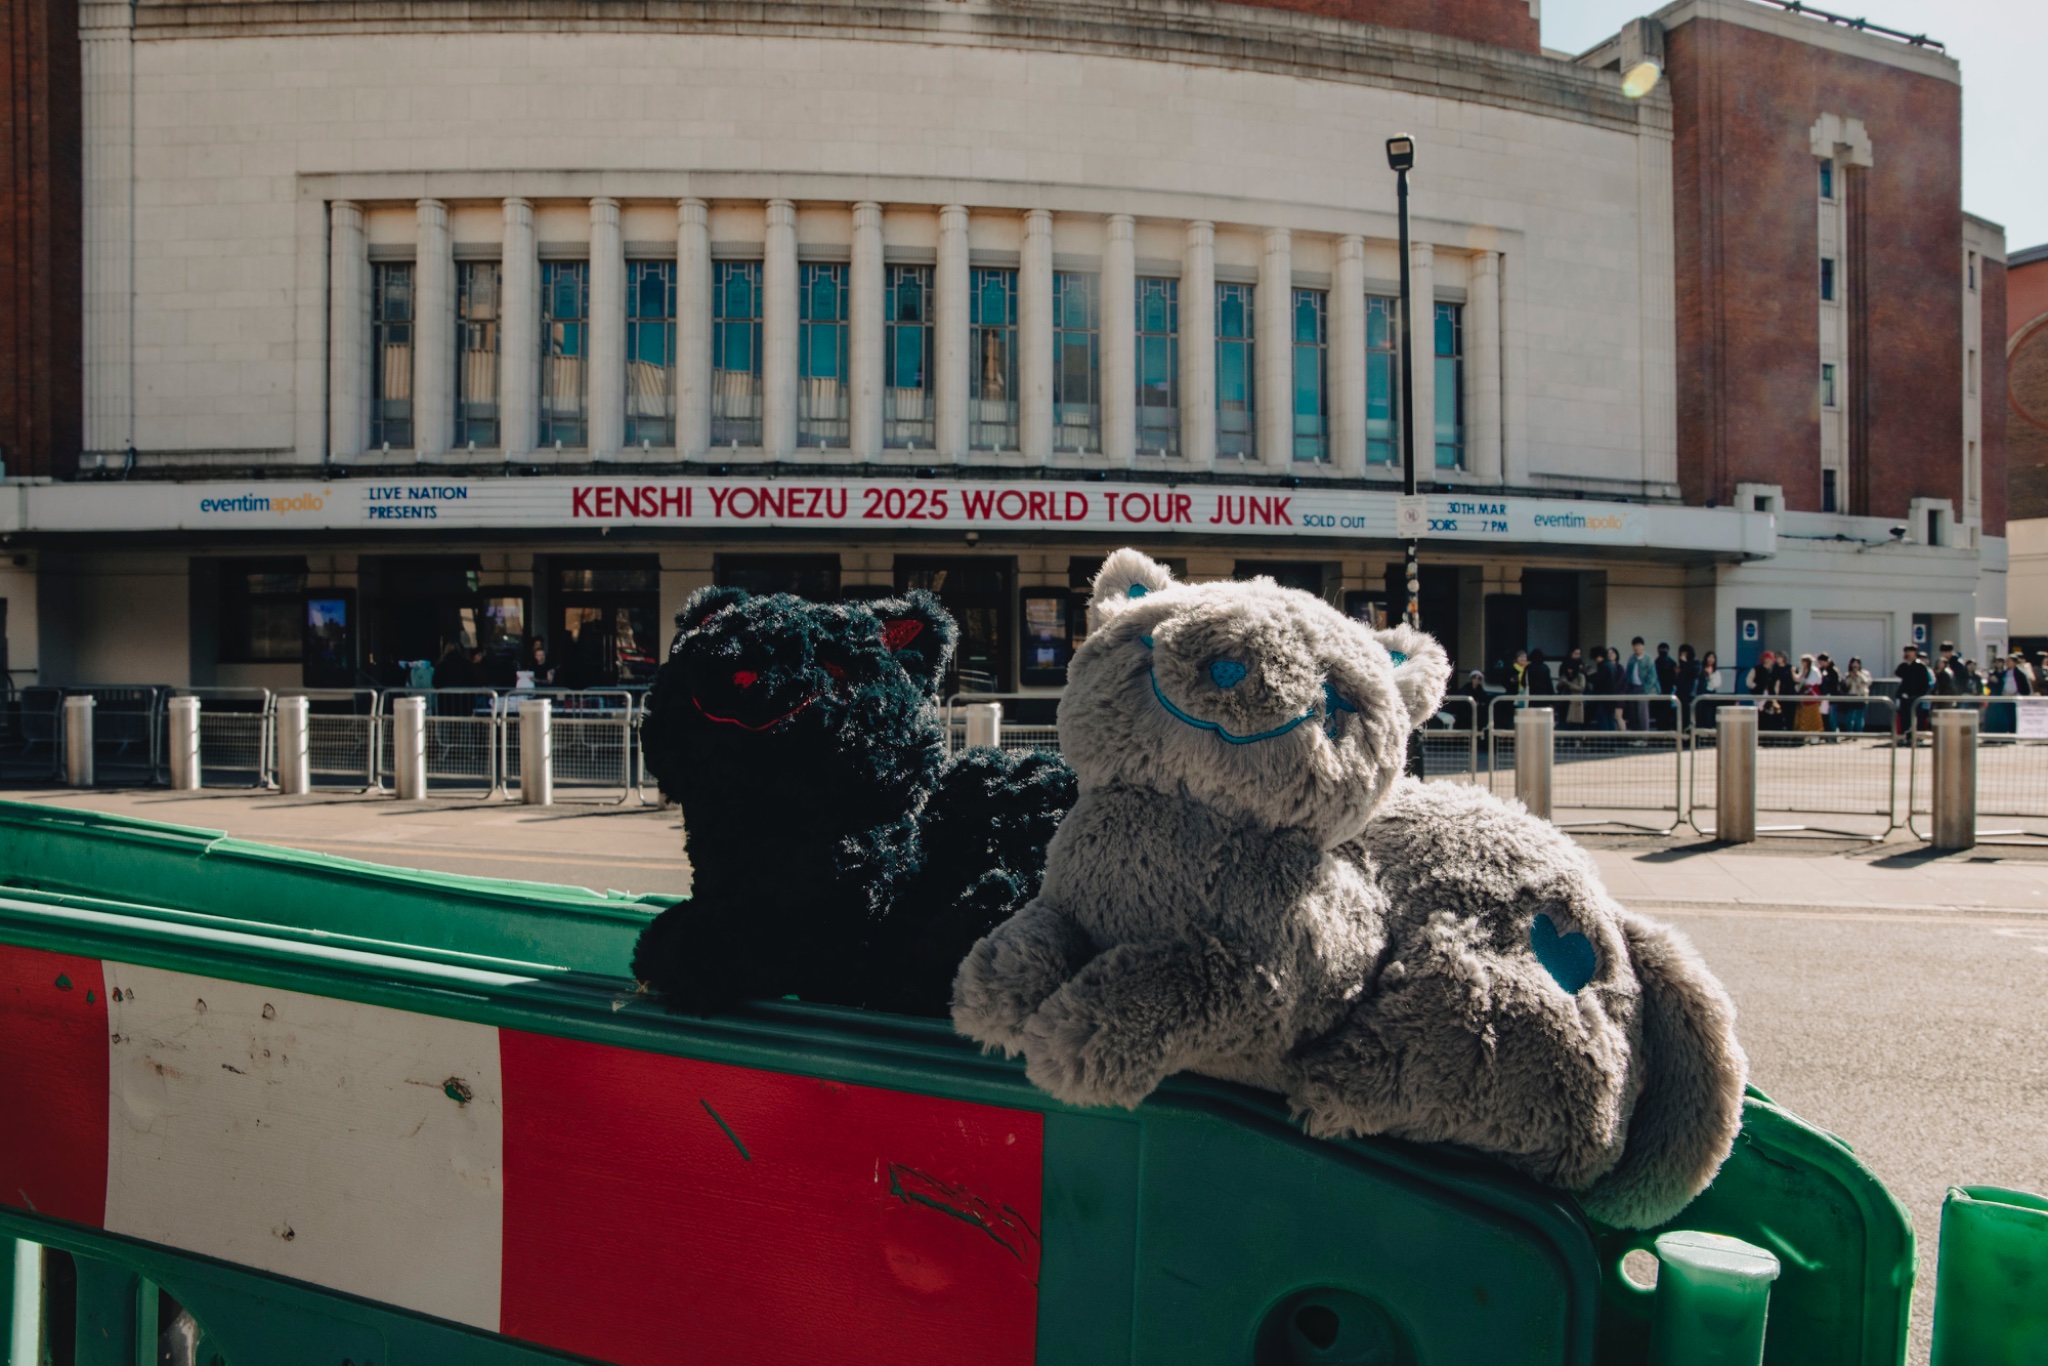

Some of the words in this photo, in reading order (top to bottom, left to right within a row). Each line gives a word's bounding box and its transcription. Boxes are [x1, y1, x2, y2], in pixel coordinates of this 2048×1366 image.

[369, 487, 402, 500] LIVE
[408, 486, 467, 500] NATION
[369, 505, 437, 519] PRESENTS
[572, 486, 692, 518] KENSHI
[708, 487, 847, 519] YONEZU
[862, 488, 948, 519] 2025
[961, 490, 1089, 521] WORLD
[1103, 492, 1193, 523] TOUR
[1209, 495, 1293, 526] JUNK
[1447, 502, 1475, 515] 30TH
[1478, 503, 1506, 516] MAR
[1302, 514, 1336, 527] SOLD
[1340, 516, 1366, 529] OUT
[1427, 519, 1458, 531] OORS
[1481, 521, 1488, 532] 7
[1491, 521, 1509, 532] PM
